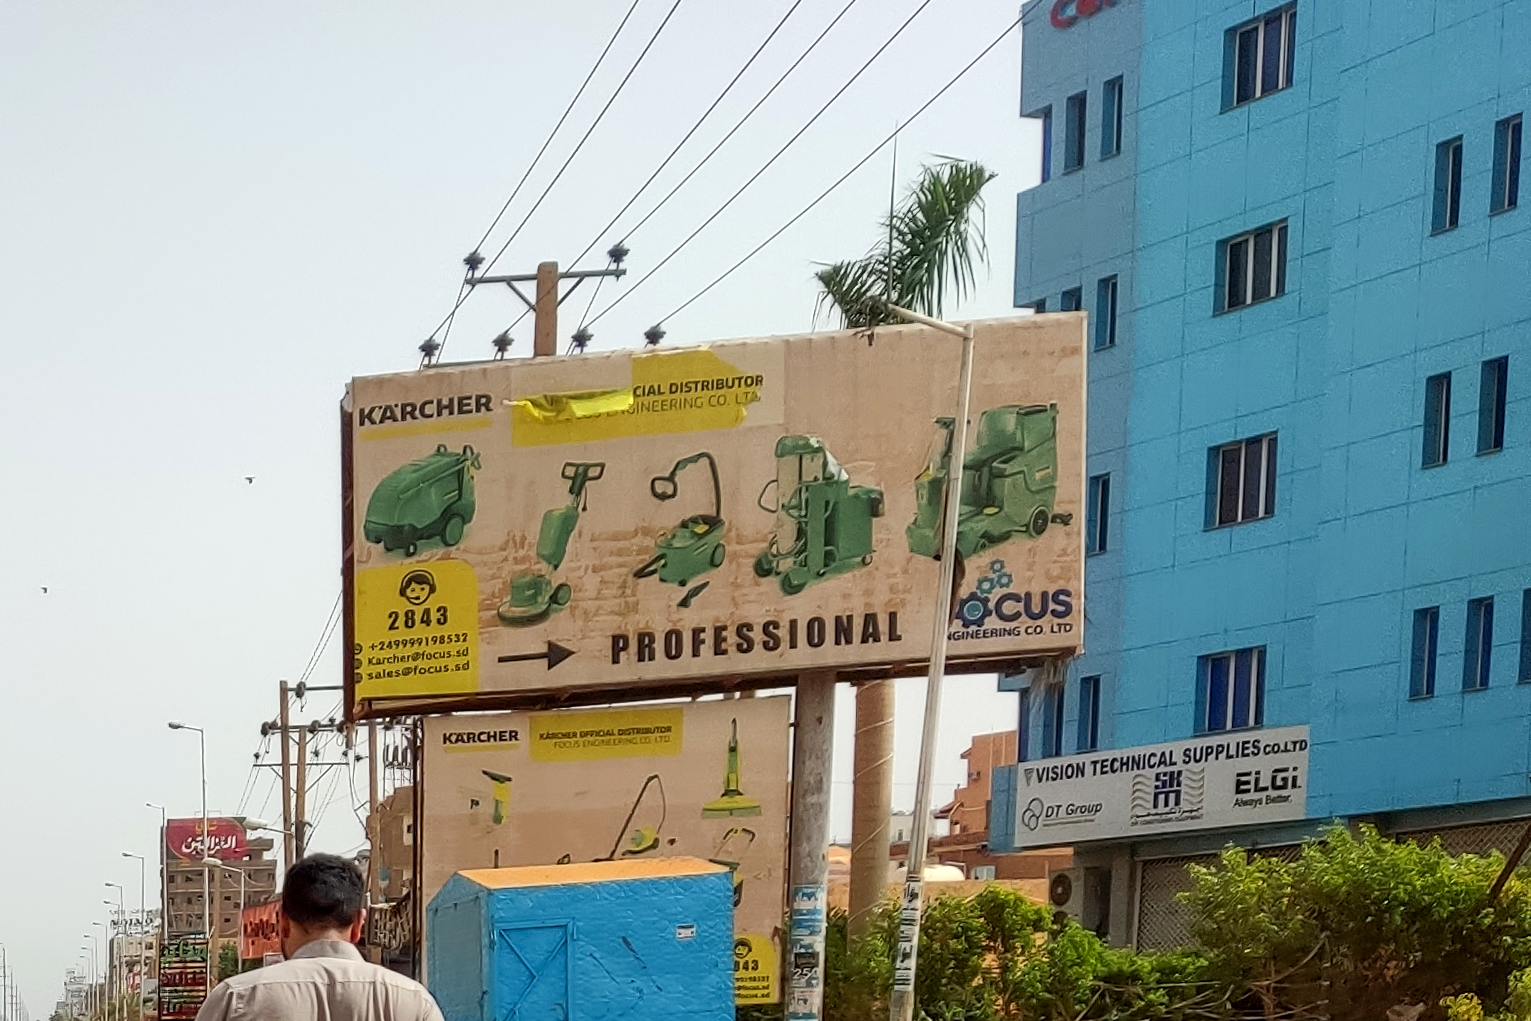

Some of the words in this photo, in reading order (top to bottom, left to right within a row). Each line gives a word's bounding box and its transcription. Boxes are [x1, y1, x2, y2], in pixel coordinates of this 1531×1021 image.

[633, 383, 666, 398] CIAL
[669, 374, 764, 395] DISTRIBUTOR
[358, 393, 494, 427] KÄRCHER
[708, 394, 730, 408] CO.
[388, 606, 449, 631] 2843
[611, 611, 902, 665] PROFESSIONAL
[947, 625, 1021, 641] NGINEERING
[1050, 622, 1073, 634] LTD
[367, 661, 470, 680] sales@focus.sd
[443, 729, 519, 745] KÄRCHER
[580, 728, 616, 739] OFFICIAL
[618, 725, 672, 736] DISTRIBUTOR
[554, 739, 580, 749] FOCUS
[583, 737, 637, 748] ENGINEERING
[1036, 761, 1086, 784] VISION
[1090, 750, 1178, 777] TECHNICAL
[1182, 739, 1261, 765] SUPPLIES
[1045, 804, 1063, 818] DT
[1066, 802, 1103, 817] Group
[734, 958, 759, 972] 43
